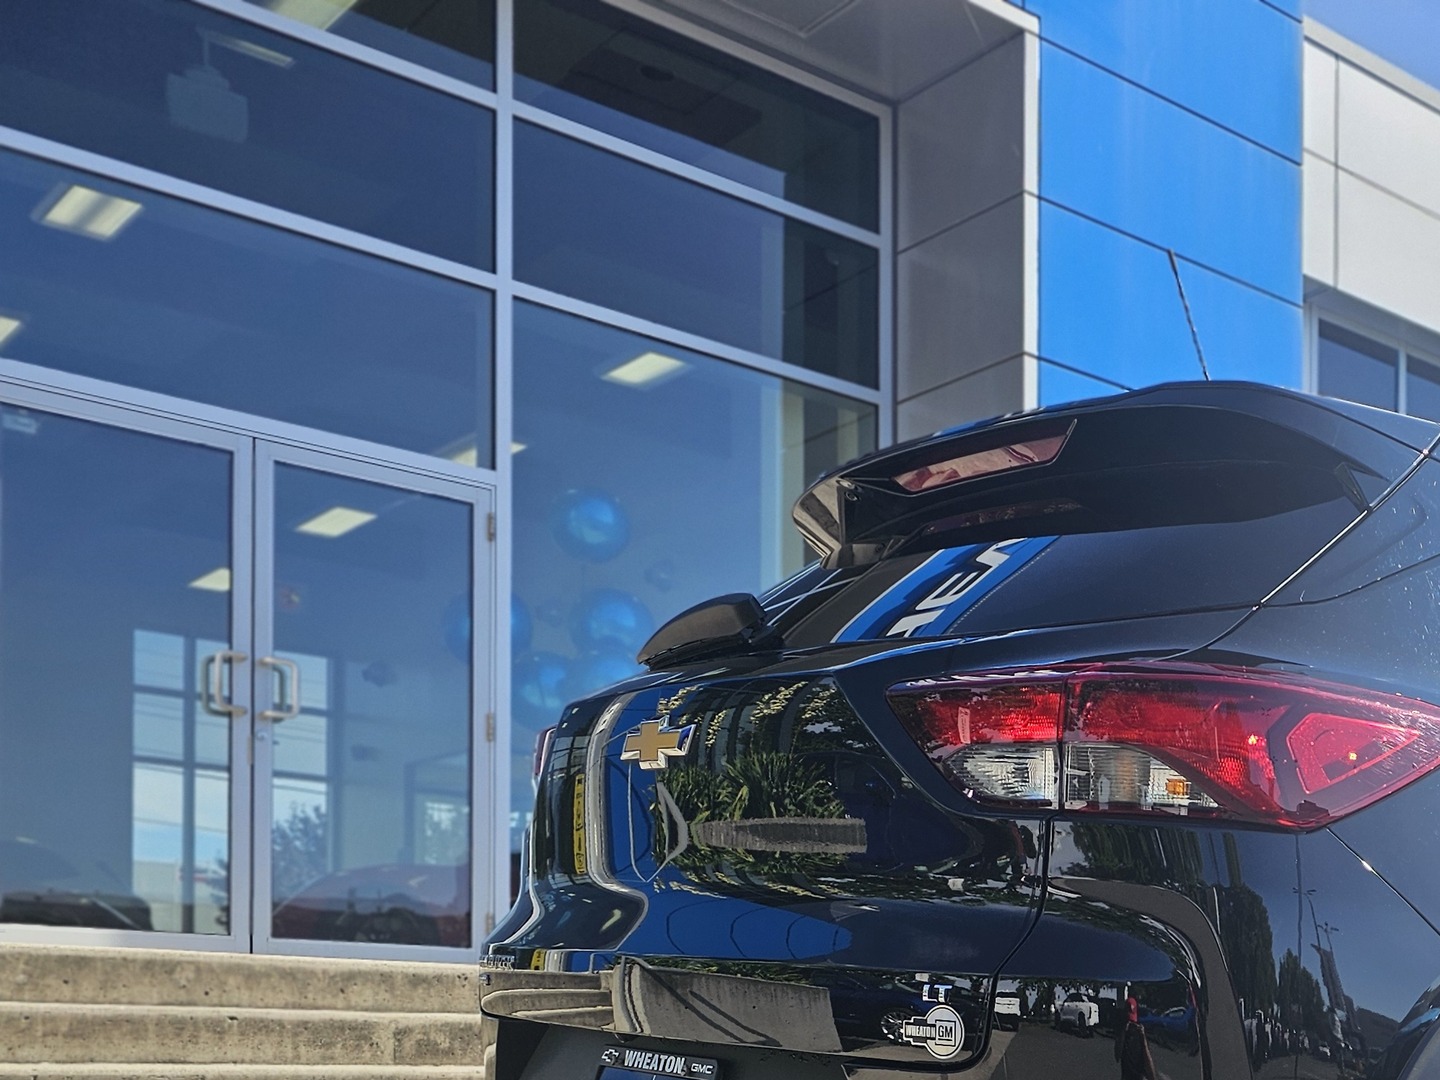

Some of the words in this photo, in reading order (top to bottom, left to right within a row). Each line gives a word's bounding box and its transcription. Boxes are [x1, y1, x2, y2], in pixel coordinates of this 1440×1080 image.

[922, 984, 953, 1003] LT
[905, 1024, 936, 1038] WHEATON
[938, 1025, 953, 1038] GM
[624, 1050, 686, 1075] WHEATON
[691, 1063, 713, 1075] GMC
